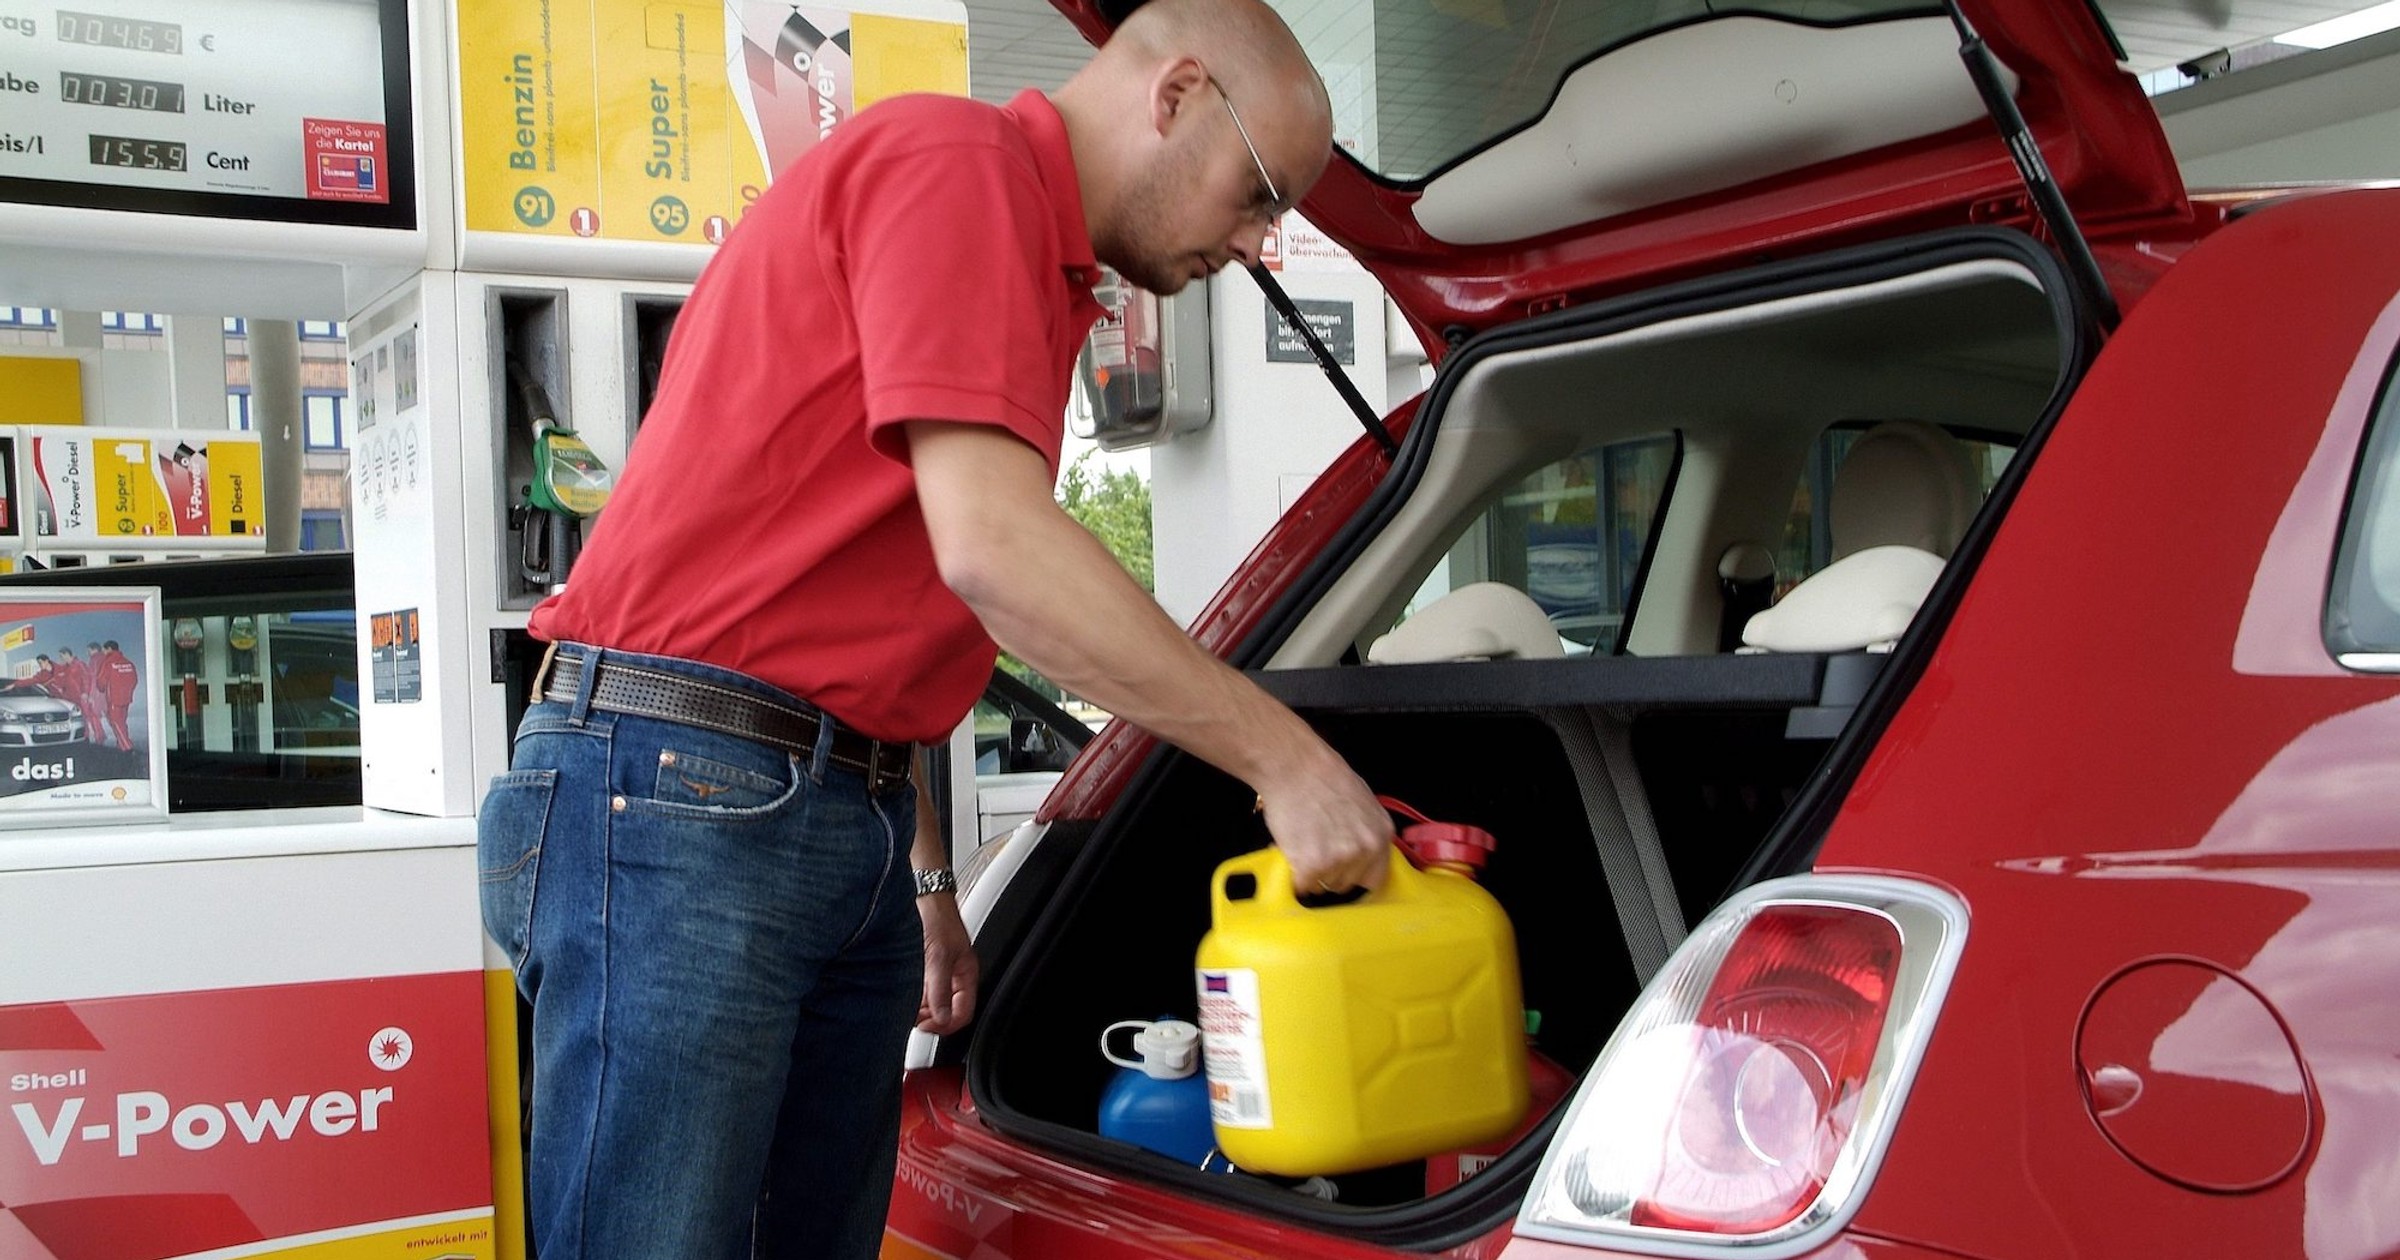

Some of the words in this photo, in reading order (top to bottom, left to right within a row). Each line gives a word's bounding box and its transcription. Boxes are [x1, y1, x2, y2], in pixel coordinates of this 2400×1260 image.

[0, 16, 36, 37] ag
[200, 34, 215, 52] €
[204, 93, 255, 115] Liter
[504, 54, 536, 171] Benzin
[817, 63, 836, 142] wer
[308, 122, 343, 138] Zeigen
[345, 124, 362, 137] Sie
[364, 129, 381, 138] uns
[316, 137, 333, 149] die
[645, 78, 678, 180] Super
[206, 151, 250, 170] Cent
[519, 194, 549, 219] 91
[652, 202, 686, 228] 95
[1289, 245, 1352, 258] überwachun
[66, 441, 79, 476] Diesel
[70, 479, 81, 528] V-Power
[116, 474, 129, 512] Super
[190, 461, 203, 519] V-Power
[230, 474, 243, 514] Diesel
[12, 757, 75, 781] das!
[11, 1069, 86, 1092] Shell
[12, 1086, 393, 1165] V-Power
[406, 1232, 465, 1249] entwickelt
[470, 1229, 488, 1241] mit
